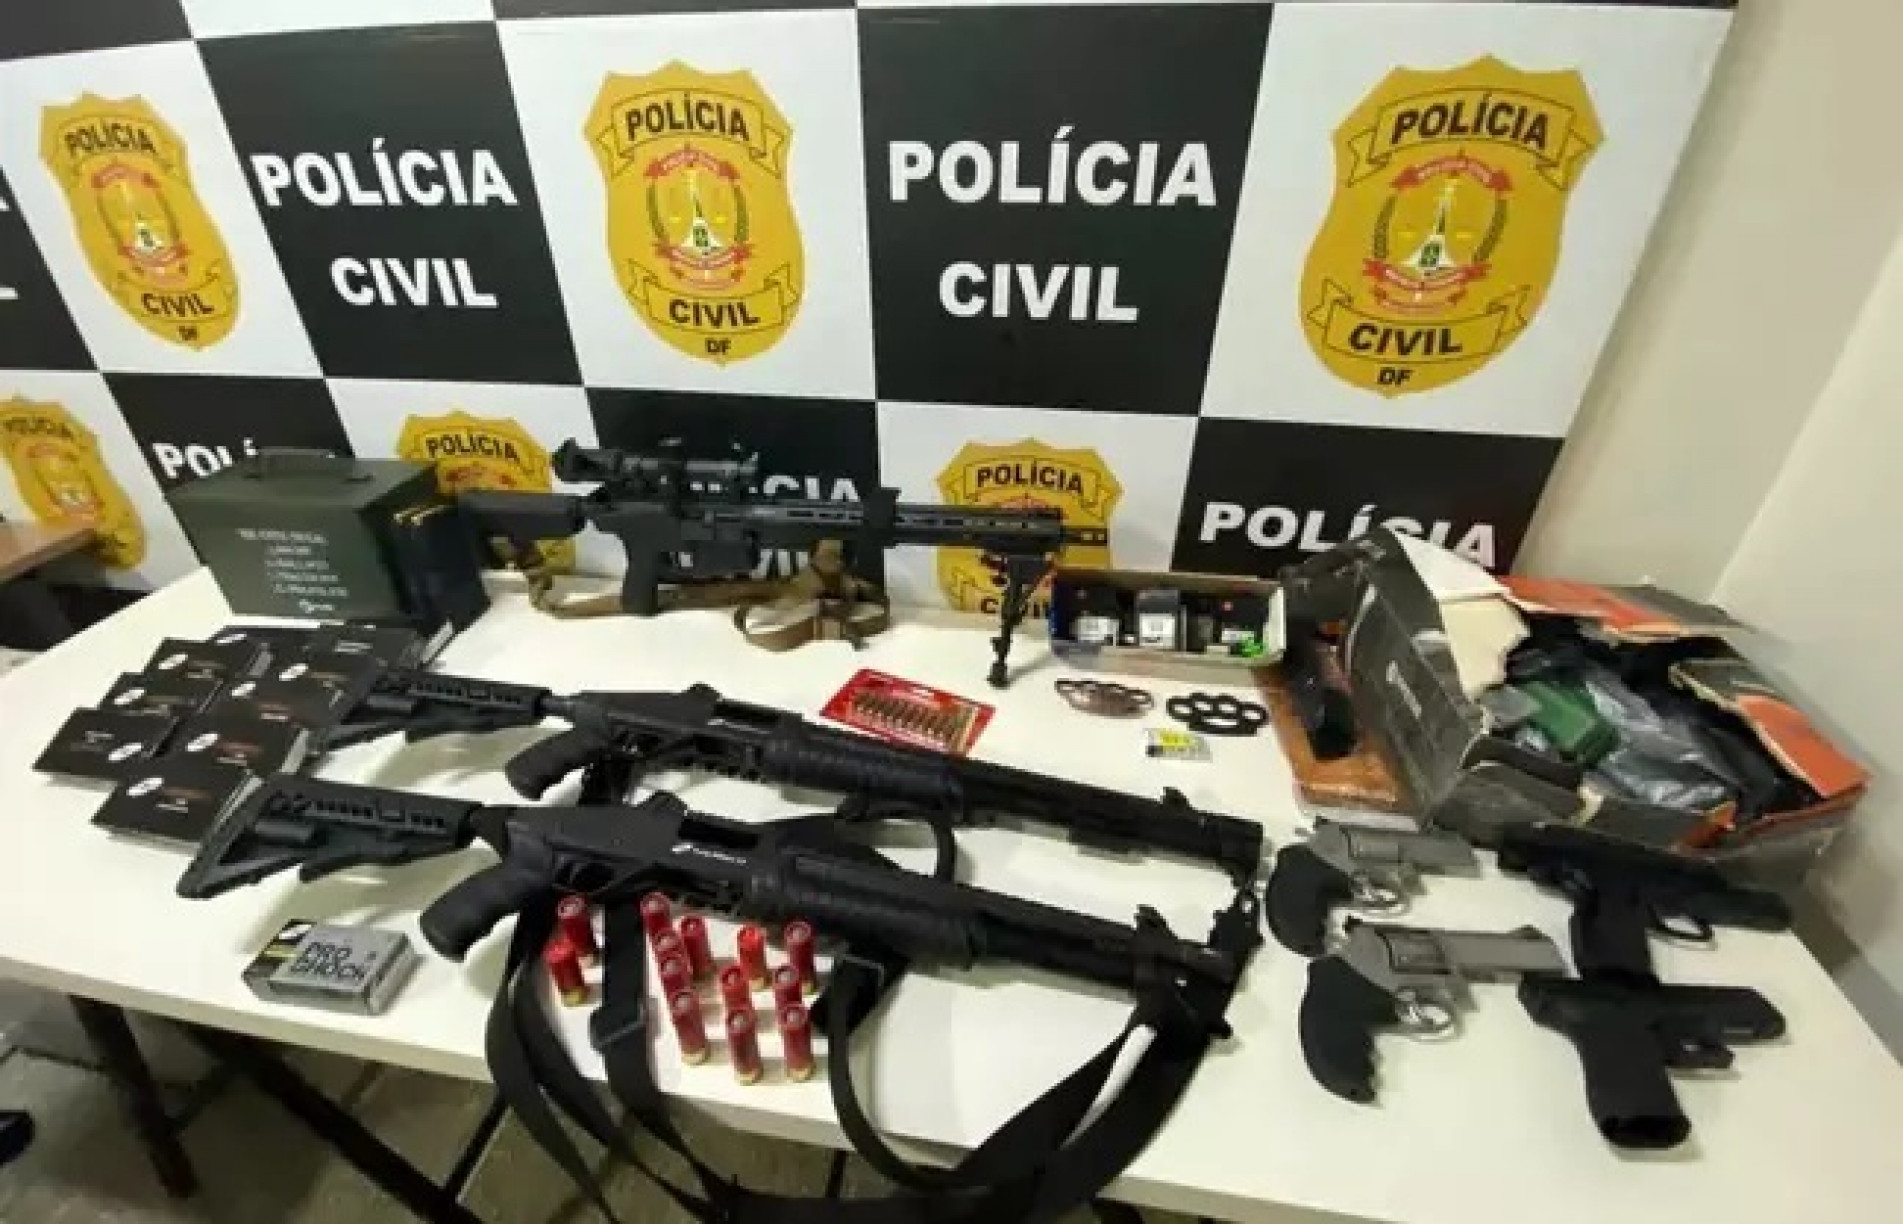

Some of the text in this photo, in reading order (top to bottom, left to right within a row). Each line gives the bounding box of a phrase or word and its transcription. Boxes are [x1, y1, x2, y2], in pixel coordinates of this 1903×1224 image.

[626, 91, 750, 142] POLÍCIA
[1390, 92, 1549, 150] POLÍCIA
[64, 121, 156, 157] POLÍCIA
[251, 137, 518, 207] POLÍCIA
[889, 125, 1217, 206] POLÍCIA
[330, 257, 498, 308] CIVIL
[938, 262, 1138, 323] CIVIL
[141, 292, 214, 318] CIVIL
[668, 299, 760, 328] CIVIL
[705, 337, 732, 356] DF
[1347, 321, 1463, 356] CIVIL
[1376, 366, 1413, 386] DF
[976, 457, 1083, 495] POLÍCIA
